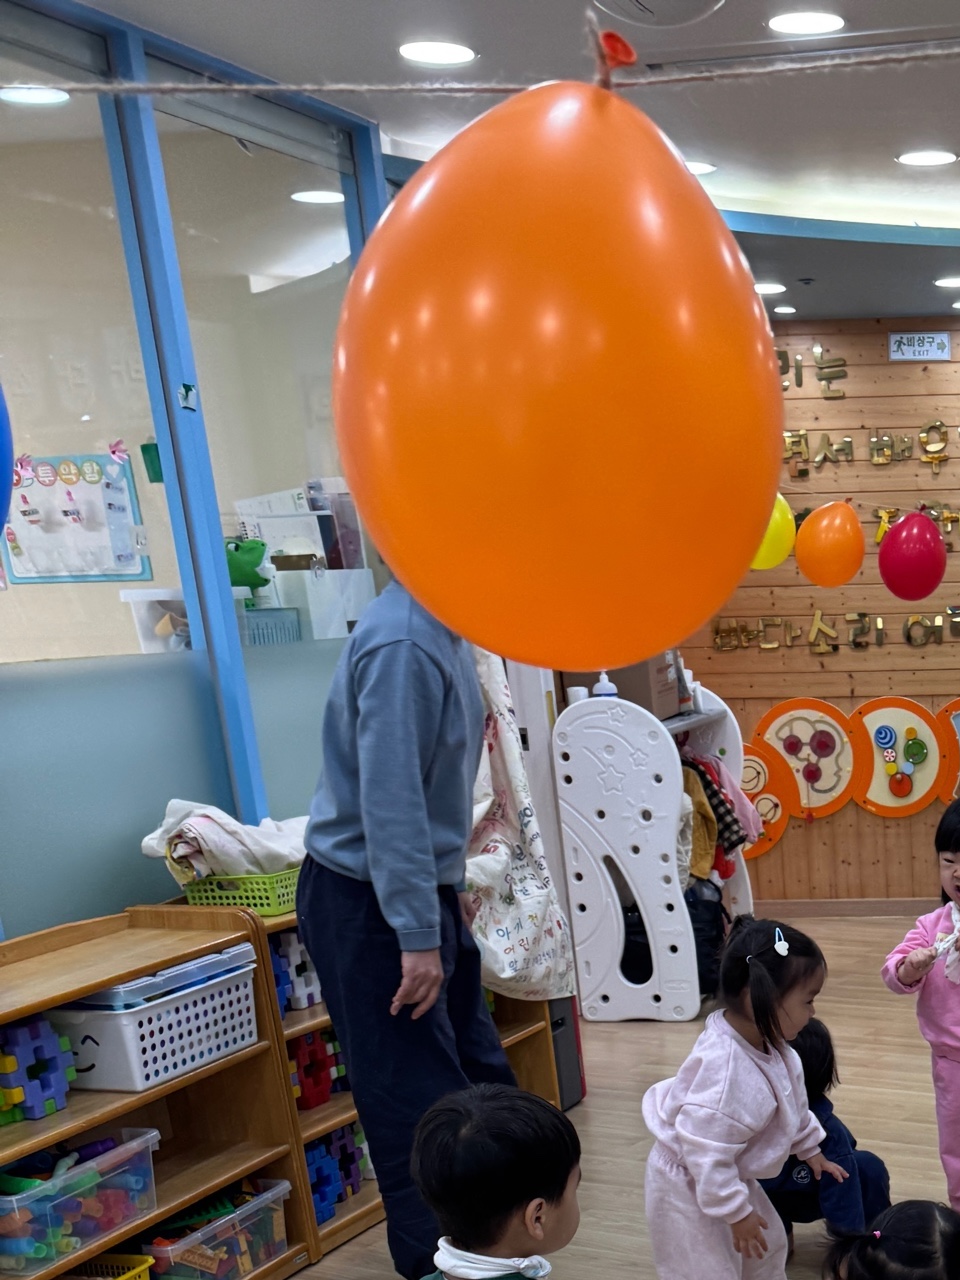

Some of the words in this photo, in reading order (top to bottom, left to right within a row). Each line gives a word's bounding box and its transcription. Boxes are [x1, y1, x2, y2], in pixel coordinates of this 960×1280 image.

[906, 335, 935, 348] 비상구
[912, 349, 930, 357] EXIT
[711, 610, 885, 654] 바다소리
